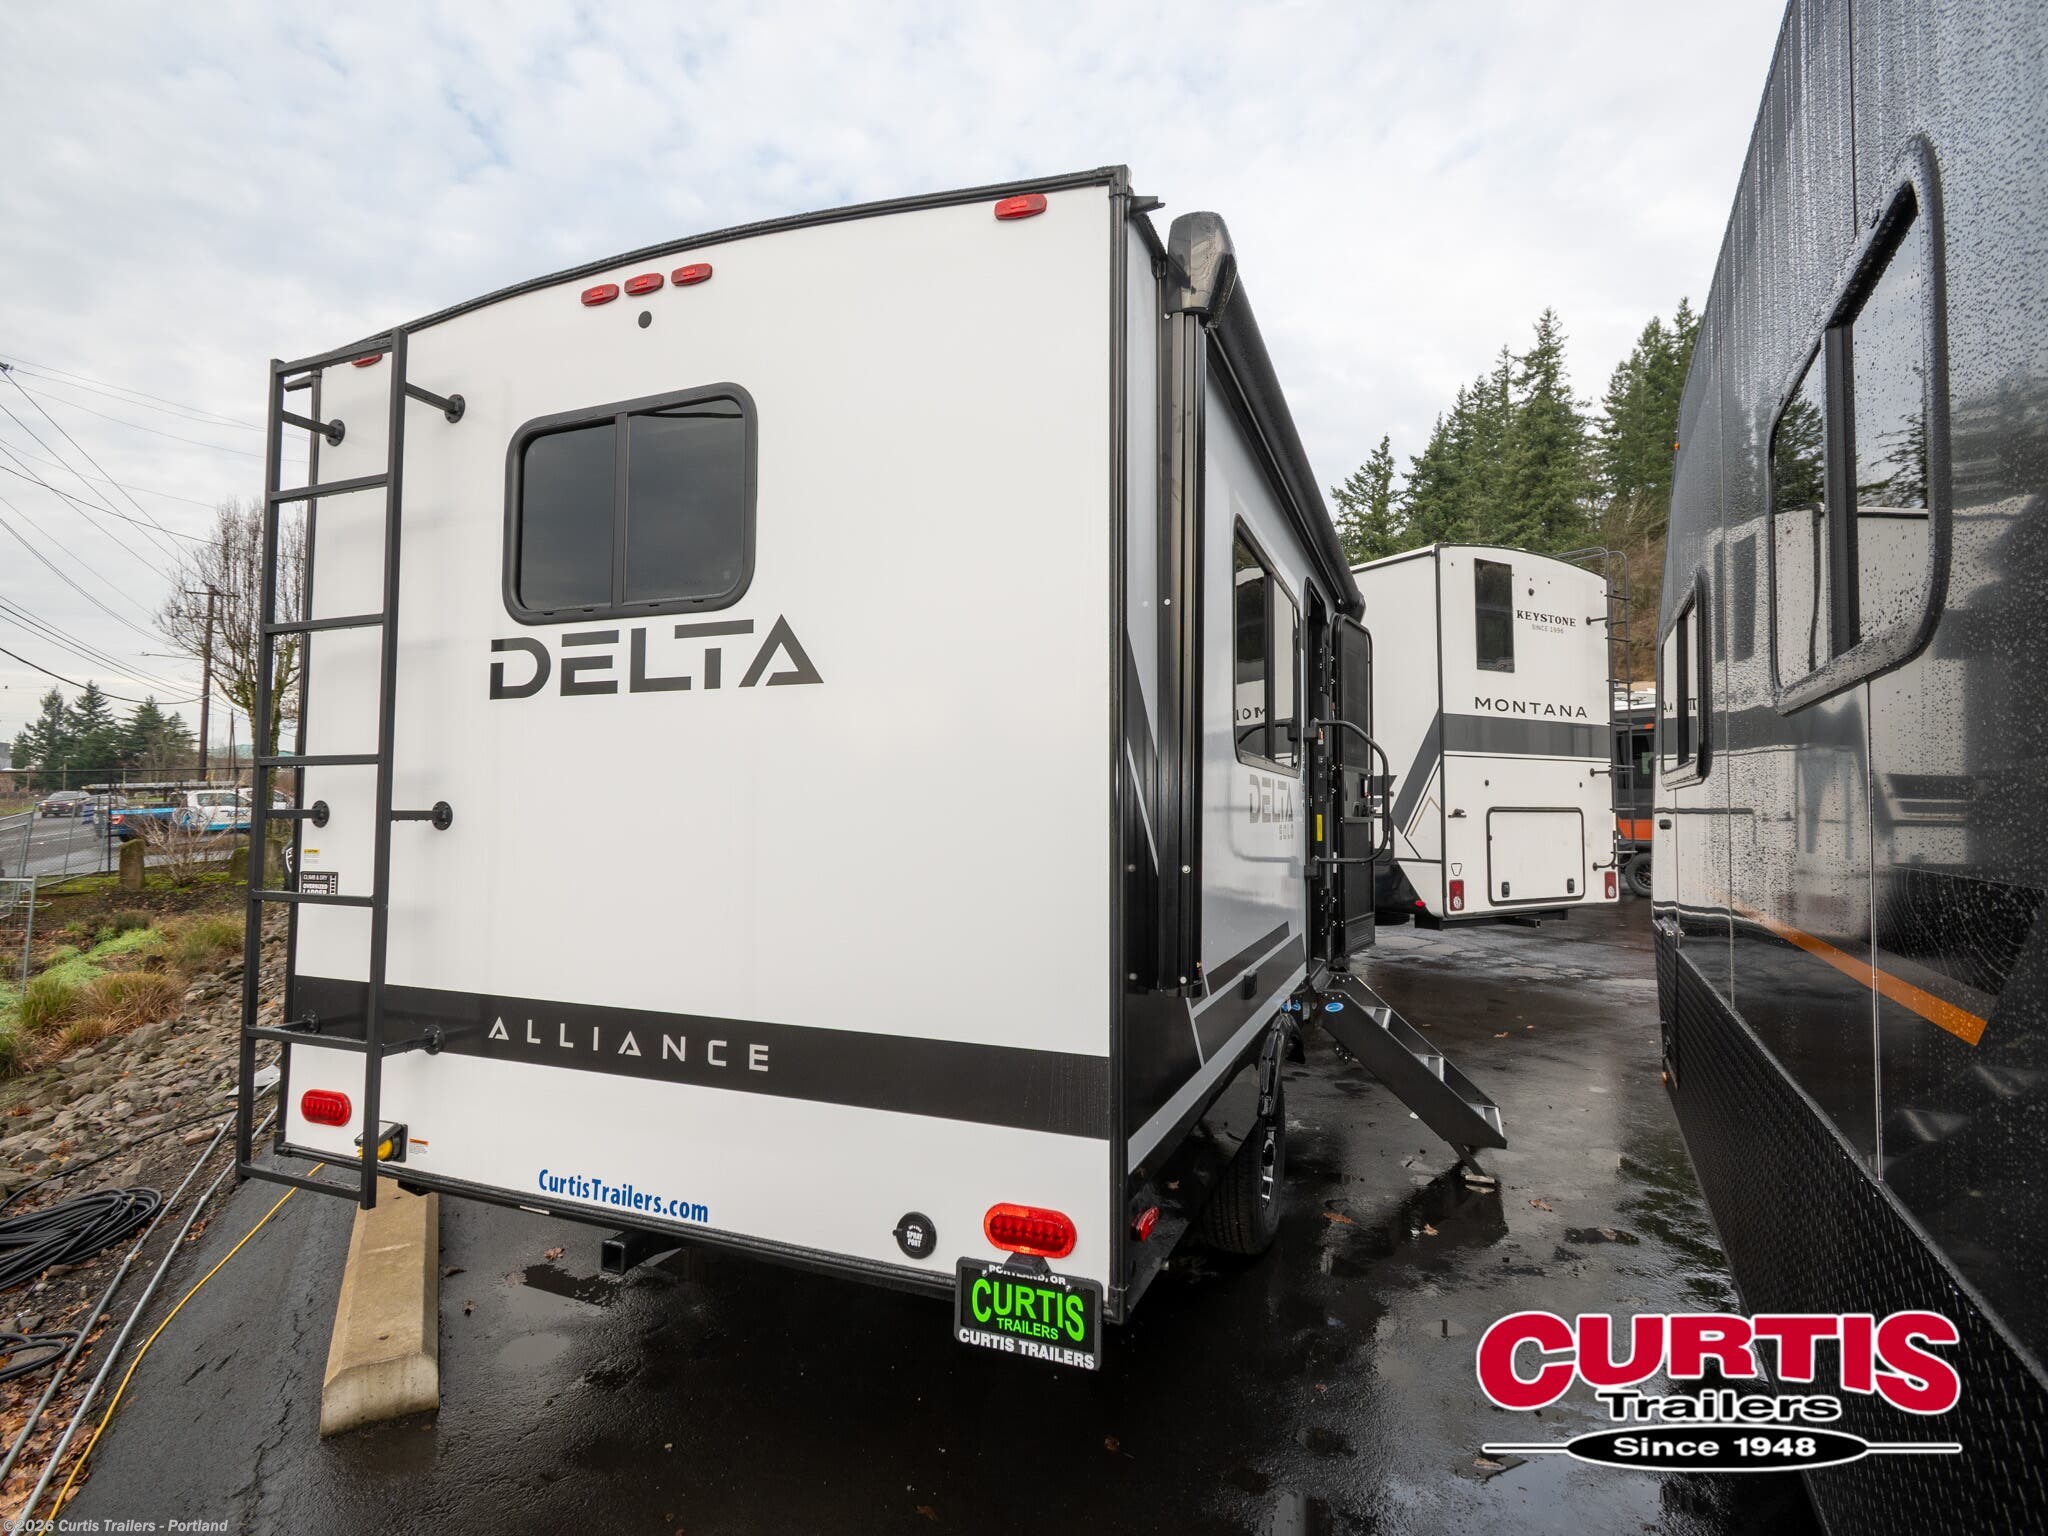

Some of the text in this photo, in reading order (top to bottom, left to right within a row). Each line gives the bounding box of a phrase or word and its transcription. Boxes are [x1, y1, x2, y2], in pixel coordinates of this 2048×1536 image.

[1516, 609, 1577, 627] KEYSTONE
[489, 613, 825, 701] DELTA
[1474, 696, 1588, 718] MONTANA
[1249, 774, 1294, 824] DELTA
[487, 1016, 769, 1072] ALLIANCE
[538, 1168, 709, 1223] CurtisTrailers.com
[1049, 1275, 1067, 1286] OR
[971, 1278, 1085, 1342] CURTIS
[996, 1317, 1059, 1340] TRAILERS
[958, 1328, 1095, 1370] CURTIS TRAILERS
